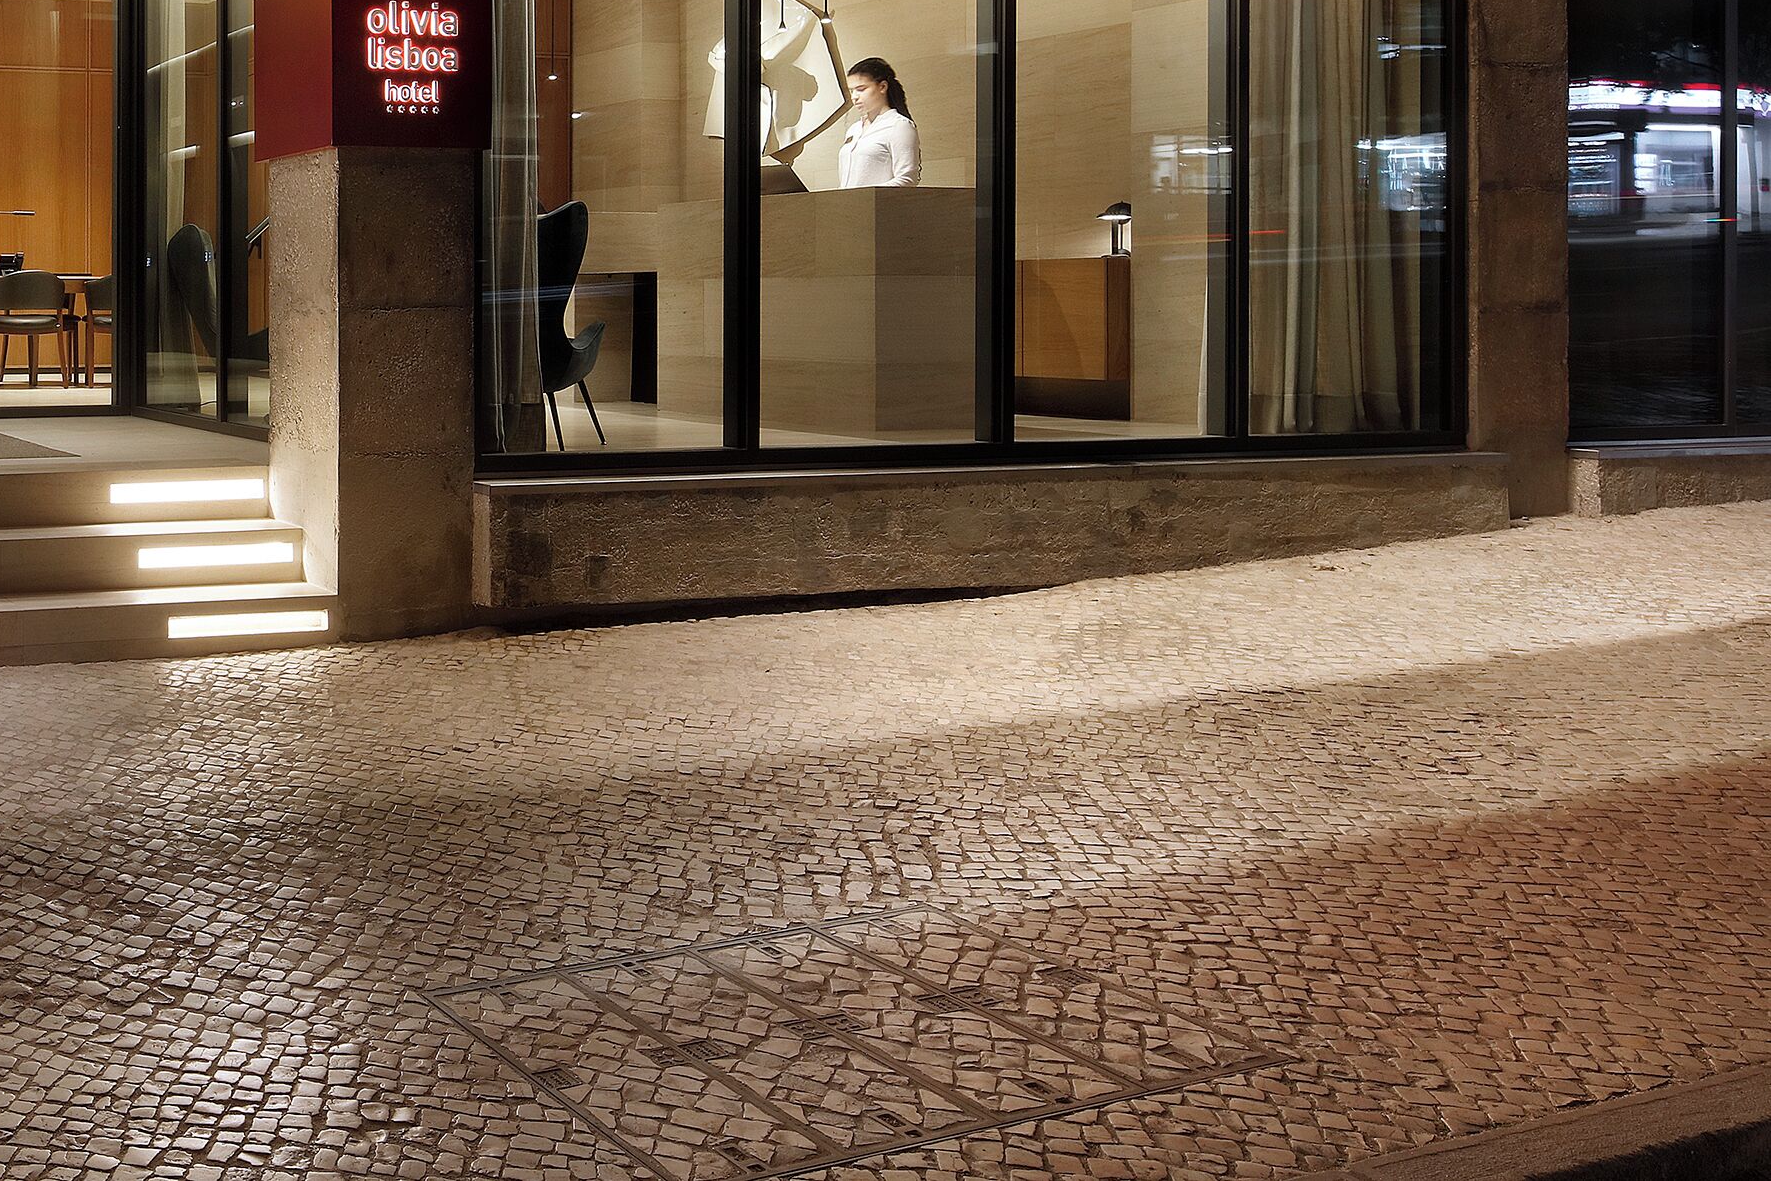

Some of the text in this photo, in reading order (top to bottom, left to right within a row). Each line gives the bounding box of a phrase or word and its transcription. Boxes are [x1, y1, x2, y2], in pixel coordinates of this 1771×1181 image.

[366, 0, 459, 37] olivia
[367, 36, 459, 72] lisboa
[384, 78, 440, 103] hotel
